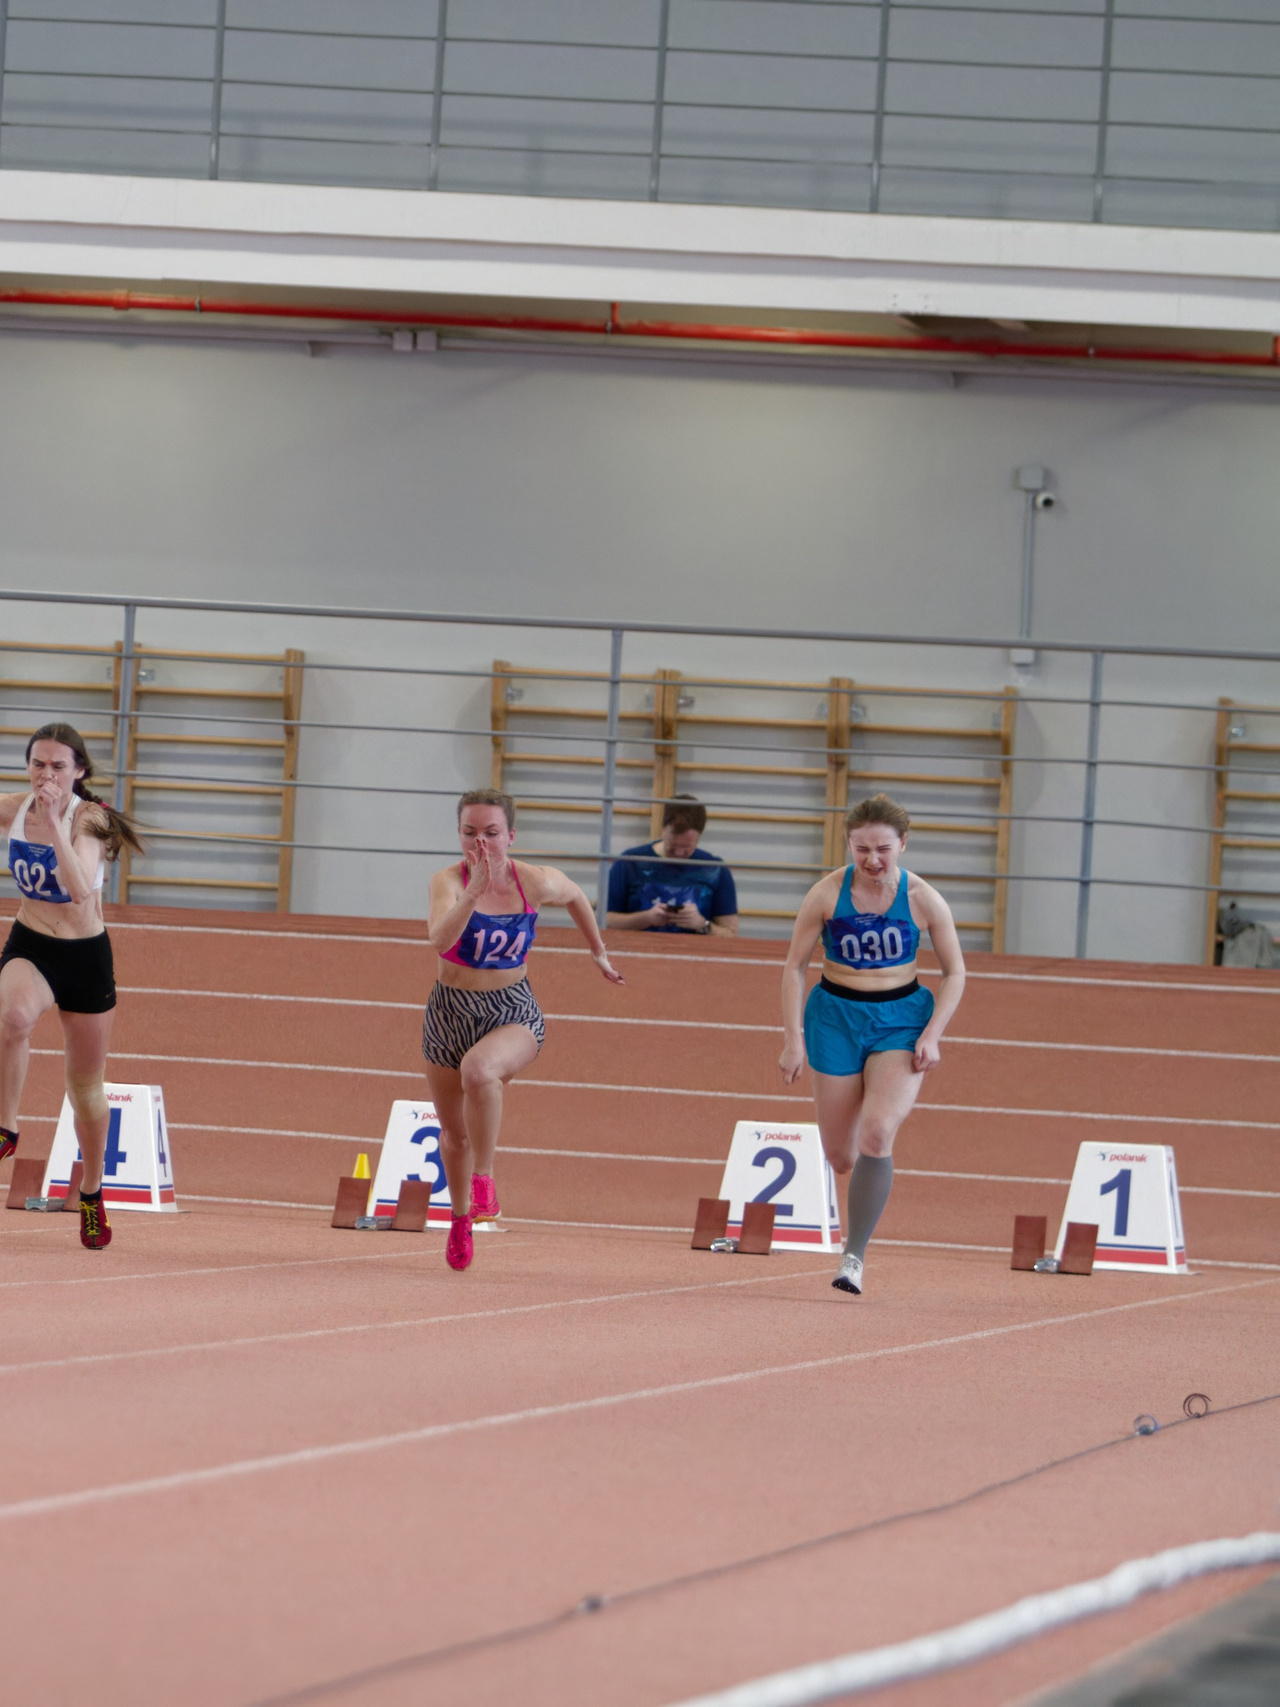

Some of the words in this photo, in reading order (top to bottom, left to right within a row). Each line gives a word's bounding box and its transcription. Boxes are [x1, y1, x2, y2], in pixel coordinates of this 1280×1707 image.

[14, 858, 68, 897] 021
[473, 928, 527, 962] 124
[840, 926, 903, 962] 030
[157, 1108, 168, 1177] 4
[764, 1131, 802, 1142] polanik
[407, 1126, 448, 1194] 3
[1109, 1152, 1147, 1163] polanik
[751, 1146, 797, 1217] 2
[1100, 1168, 1132, 1237] 1
